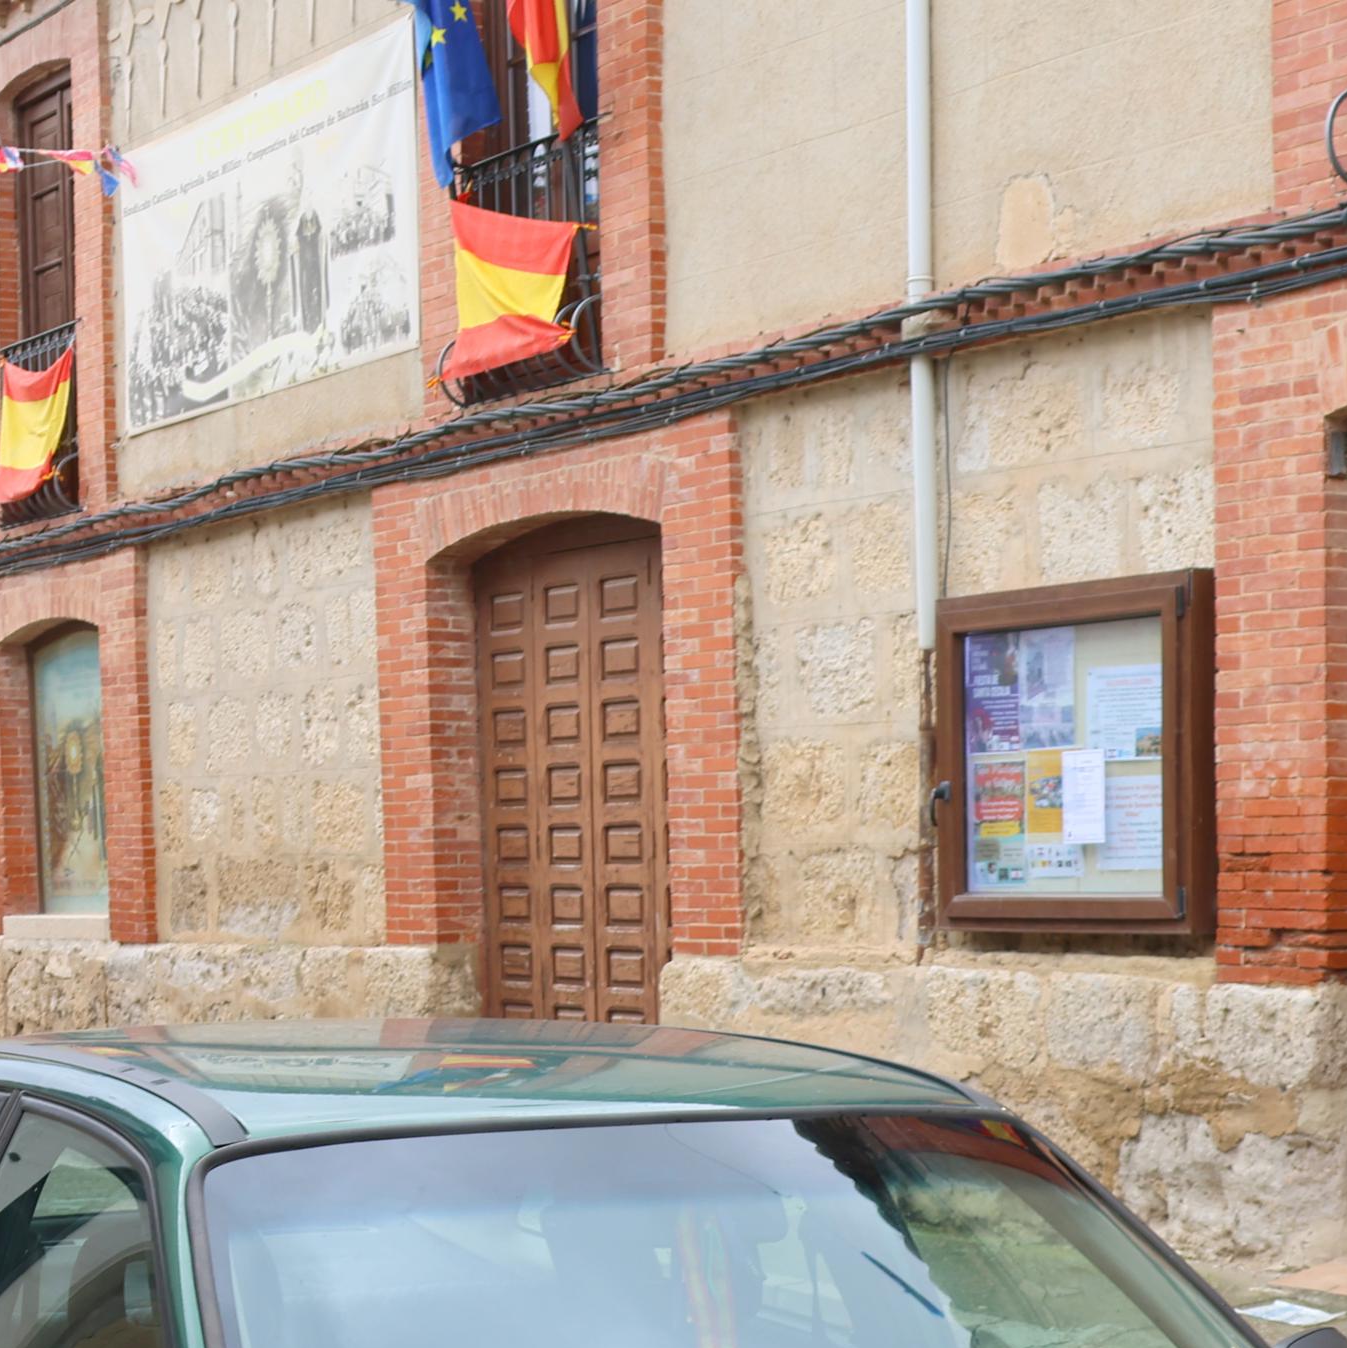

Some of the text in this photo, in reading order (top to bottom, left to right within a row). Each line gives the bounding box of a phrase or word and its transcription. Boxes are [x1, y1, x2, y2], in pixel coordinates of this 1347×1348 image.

[288, 129, 300, 144] del
[301, 121, 325, 138] Campo
[326, 114, 336, 127] de
